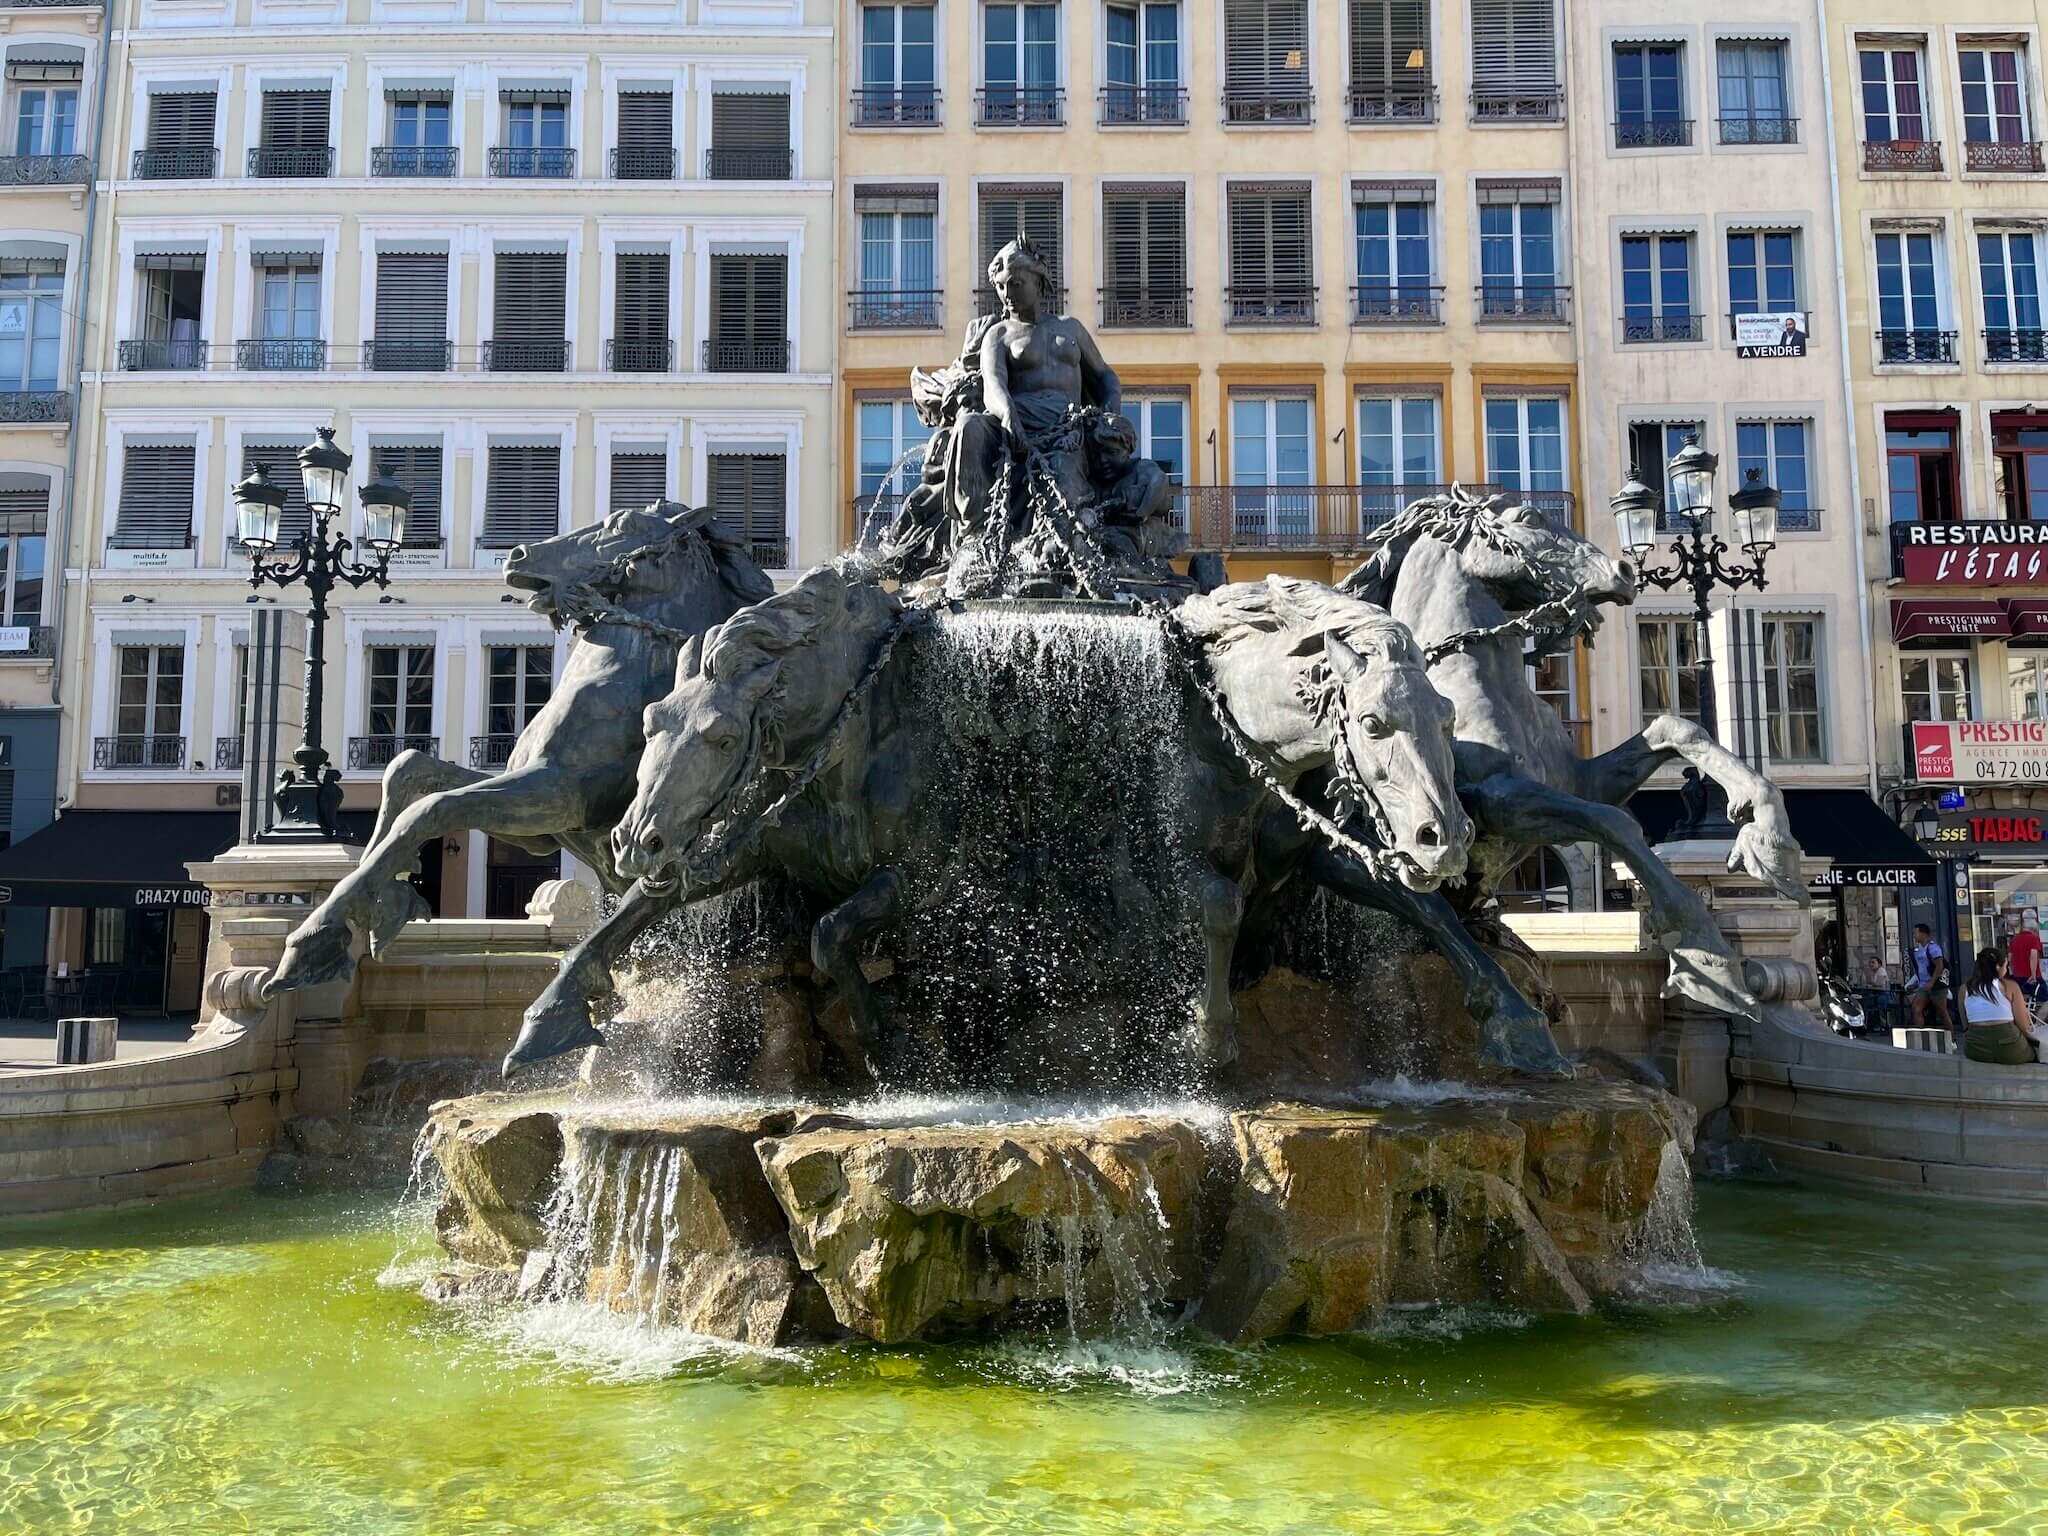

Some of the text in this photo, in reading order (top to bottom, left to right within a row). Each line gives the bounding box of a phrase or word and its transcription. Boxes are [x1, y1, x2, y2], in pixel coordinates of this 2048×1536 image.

[1742, 346, 1800, 357] A VENDRE
[133, 552, 168, 560] multifa.fr
[1928, 616, 1997, 625] PRESTIG'IMMO
[1949, 624, 1980, 633] VENTE
[1966, 748, 2009, 757] AGENCE
[1919, 765, 1951, 773] IMMO
[1976, 761, 1996, 778] 04
[1999, 761, 2018, 778] 72
[2022, 761, 2041, 778] 00
[1969, 816, 2043, 843] TABAC
[1856, 869, 1917, 884] GLACIER
[135, 889, 210, 906] CRAZY DOG
